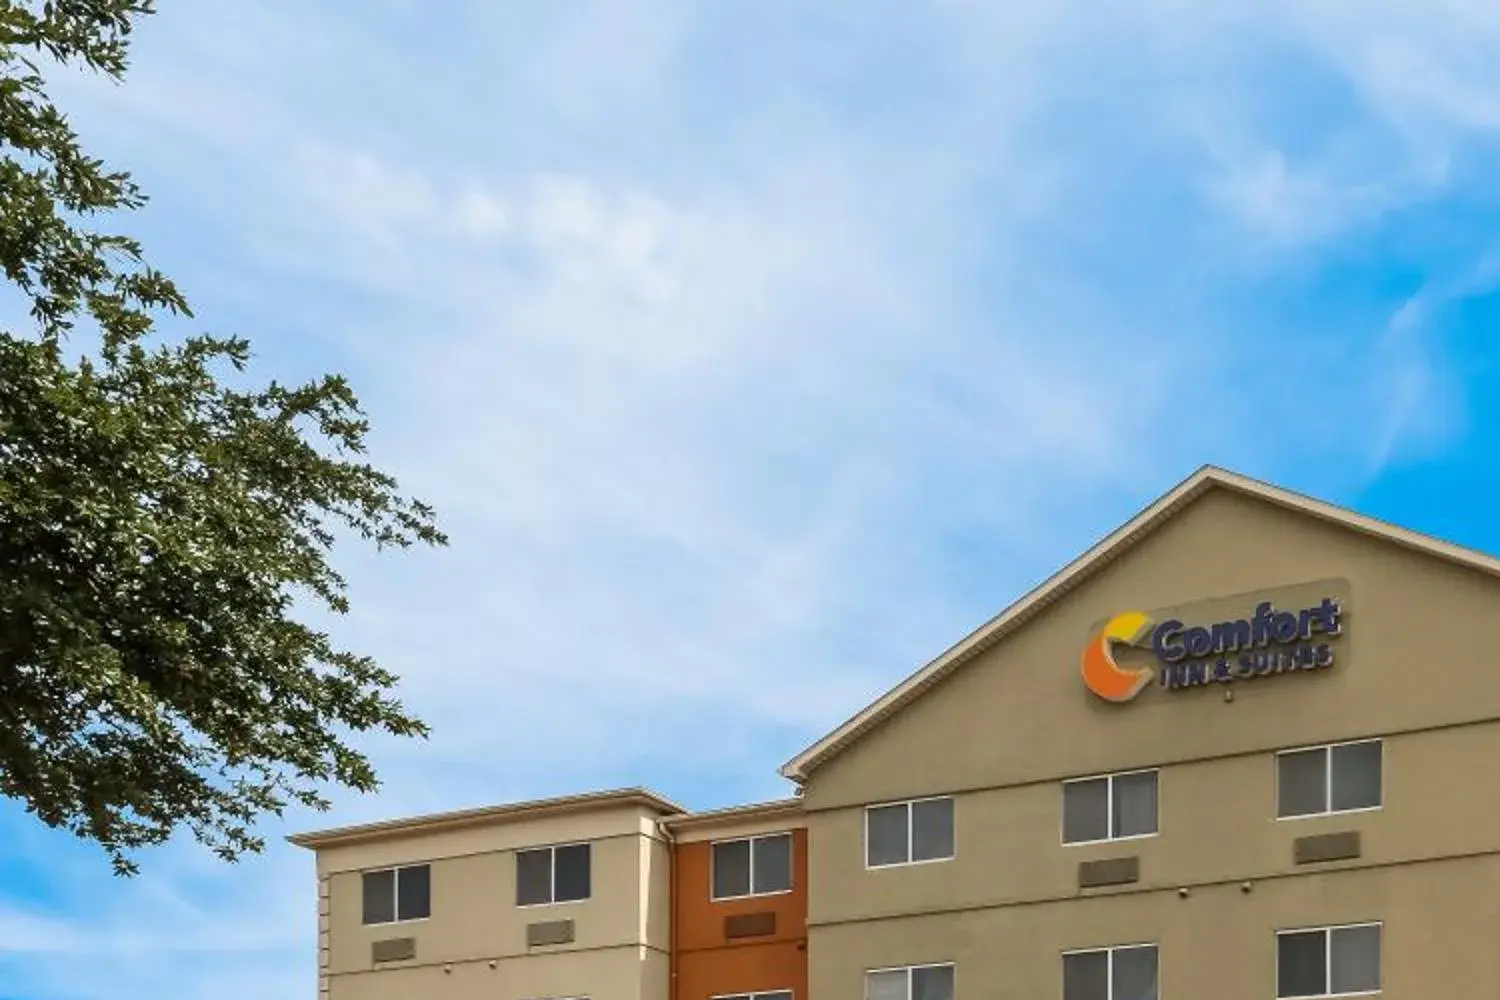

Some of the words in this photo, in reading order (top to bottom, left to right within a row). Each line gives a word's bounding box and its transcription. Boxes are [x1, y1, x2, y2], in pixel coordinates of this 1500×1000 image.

[1153, 597, 1342, 662] Comfort
[1161, 662, 1211, 689] INN
[1239, 643, 1333, 677] SUITES
